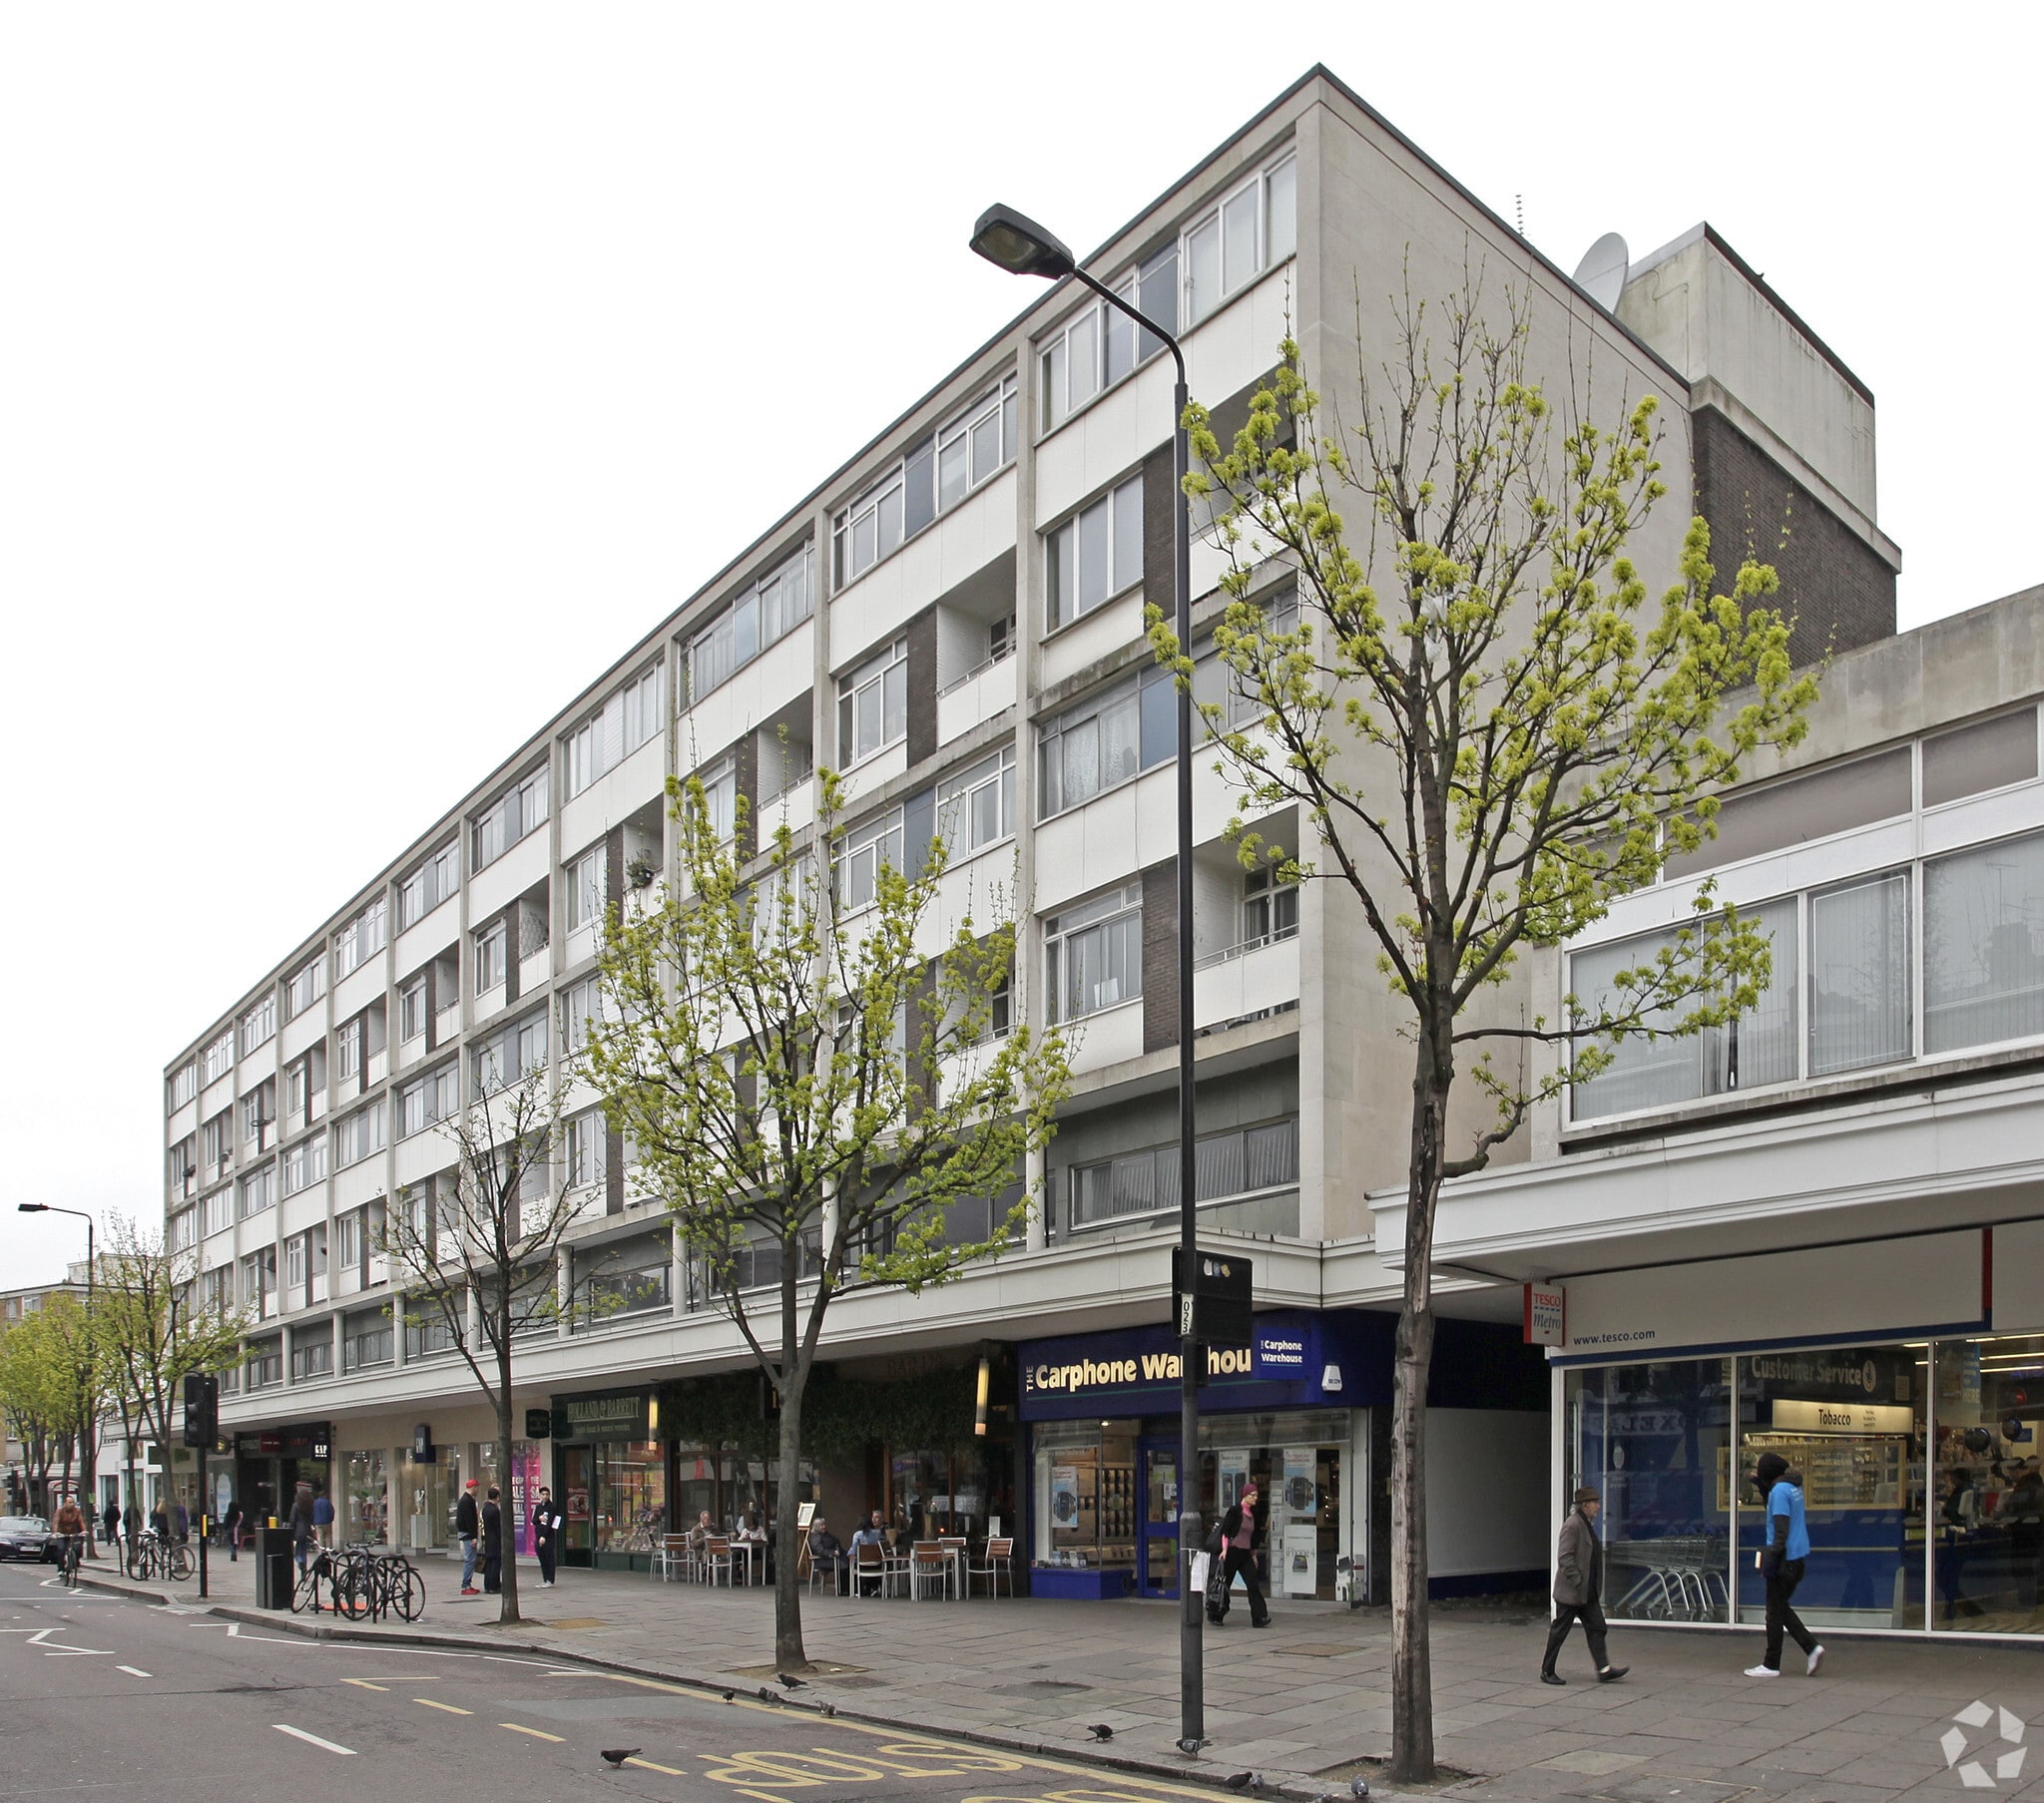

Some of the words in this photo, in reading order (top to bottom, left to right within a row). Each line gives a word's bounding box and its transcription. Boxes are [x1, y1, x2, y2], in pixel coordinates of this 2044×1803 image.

[1533, 1293, 1561, 1307] TESCO
[1182, 1301, 1191, 1333] 023
[1533, 1313, 1561, 1329] Metro
[1265, 1340, 1302, 1352] Carphone
[1573, 1329, 1656, 1346] www.tesco.com
[1261, 1353, 1302, 1363] Warehouse
[1035, 1358, 1137, 1392] Carphone
[1752, 1356, 1814, 1382] Customer
[1816, 1358, 1862, 1386] Service
[1818, 1409, 1851, 1426] Tobacco
[1285, 1548, 1309, 1559] iPhone
[697, 1743, 1023, 1788] STOP
